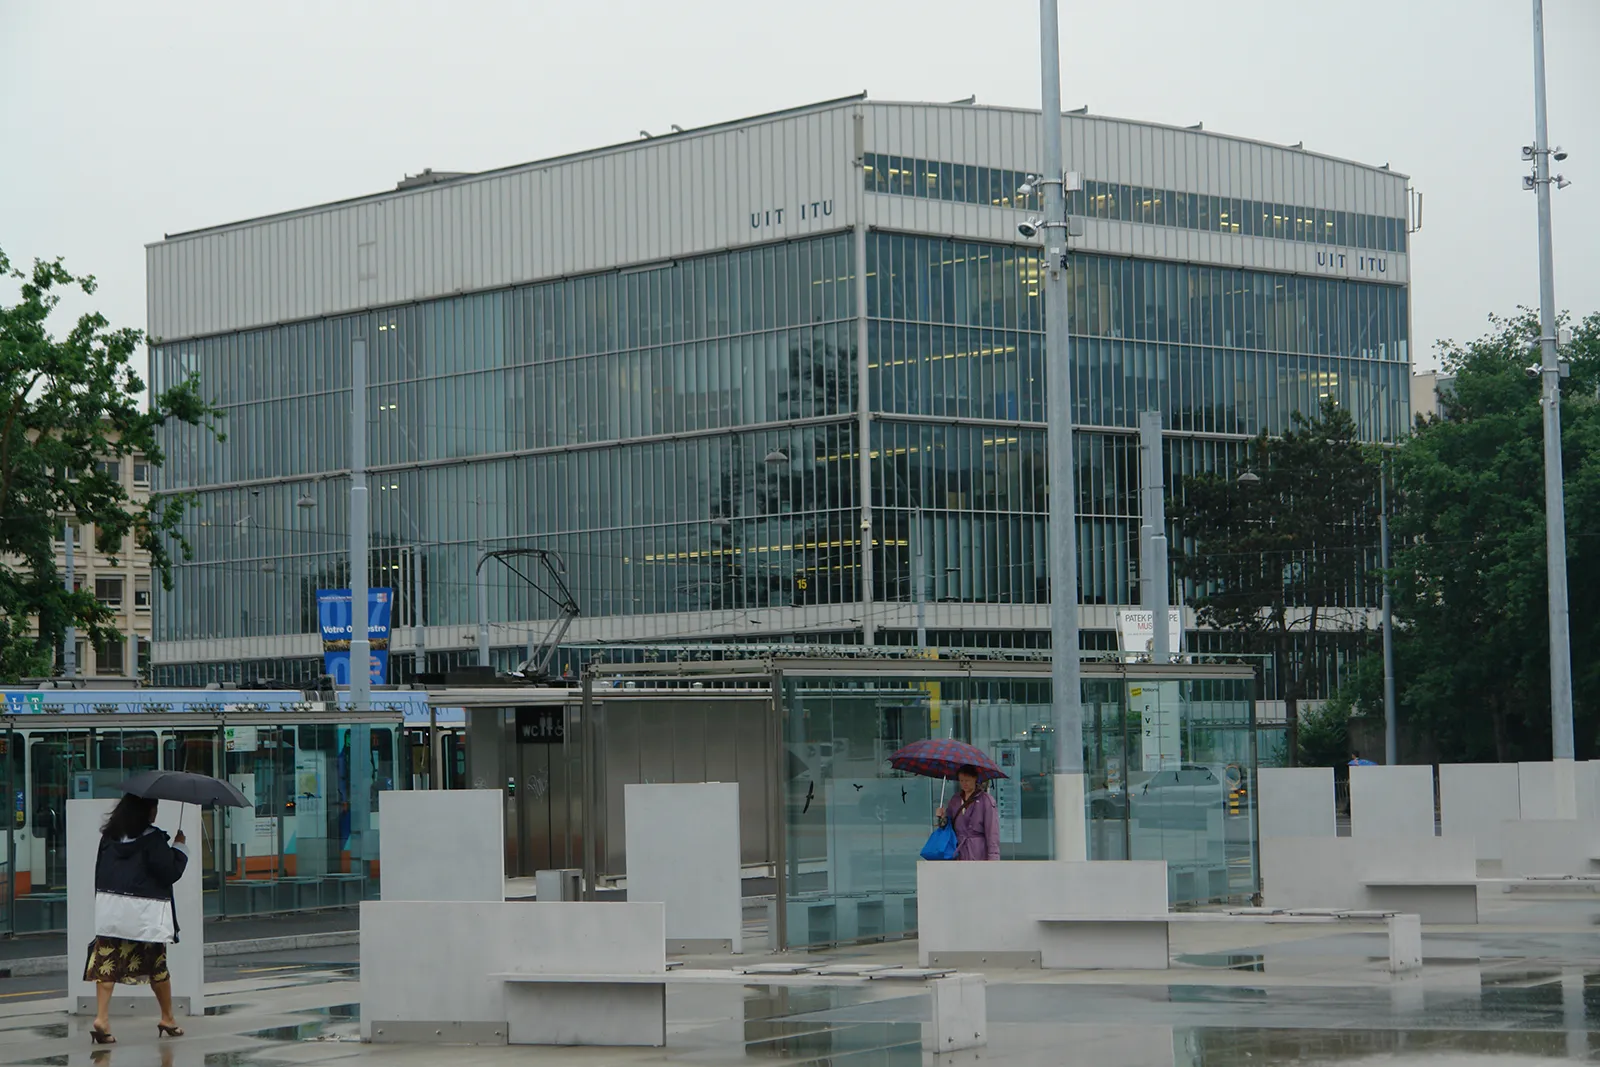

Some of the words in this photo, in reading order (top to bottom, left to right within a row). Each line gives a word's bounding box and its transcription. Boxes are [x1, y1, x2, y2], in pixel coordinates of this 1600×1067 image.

[751, 208, 783, 229] UIT
[801, 199, 832, 220] ITU
[1318, 252, 1345, 268] UIT
[1360, 256, 1386, 272] ITU
[1125, 614, 1147, 622] PATEK
[323, 625, 345, 634] Votre
